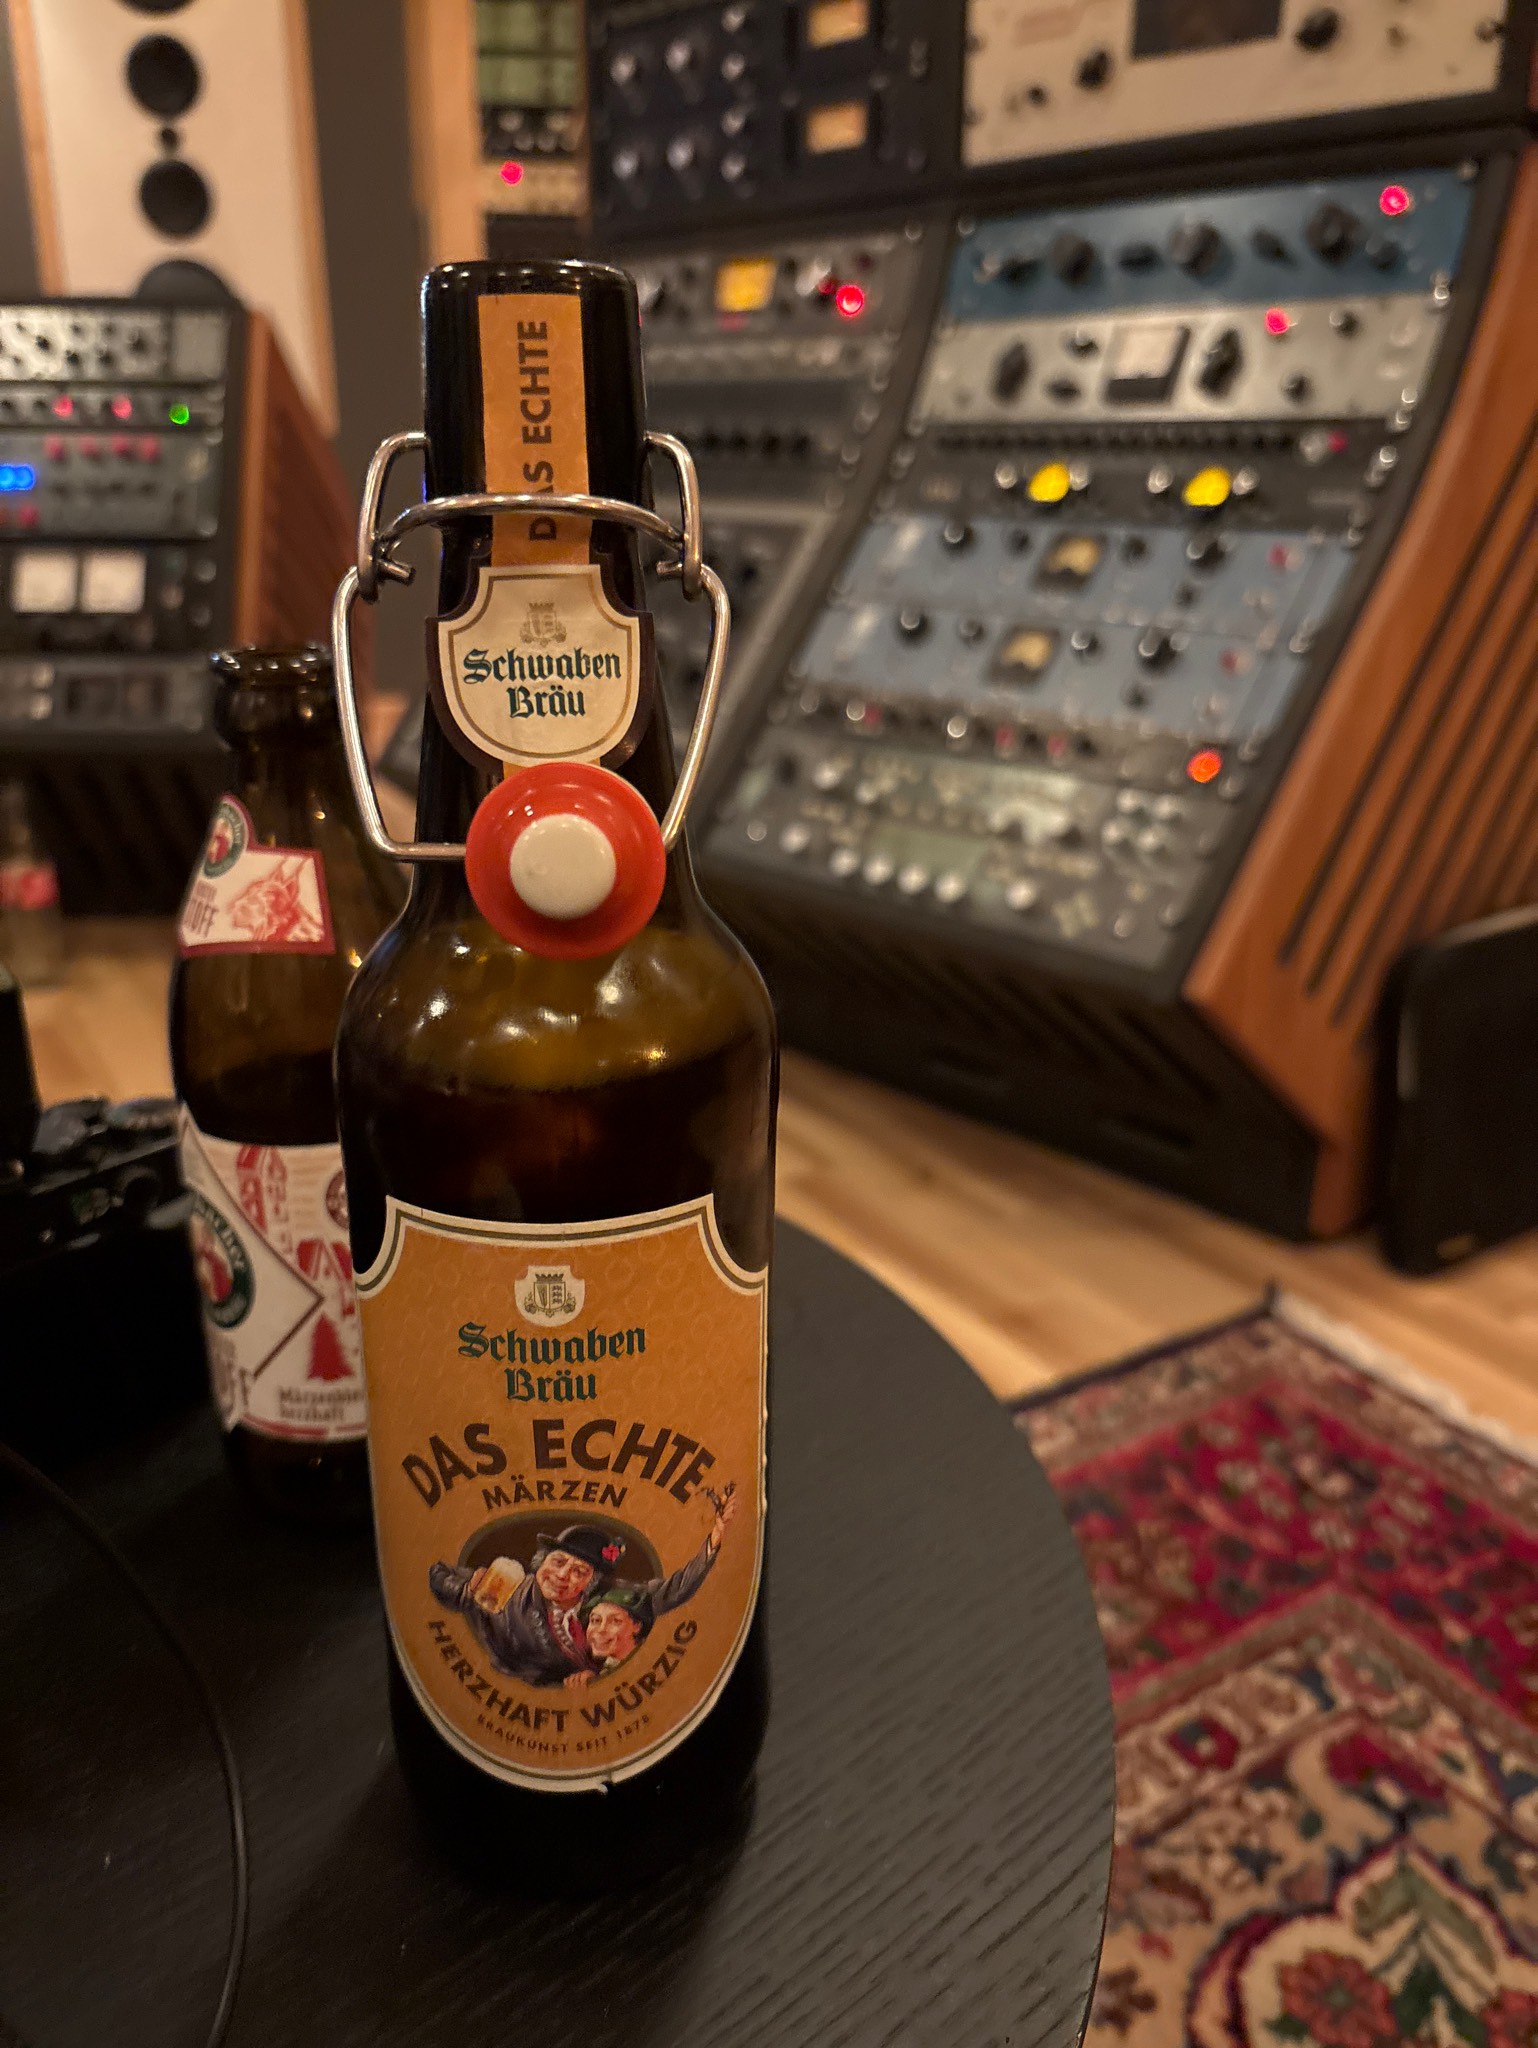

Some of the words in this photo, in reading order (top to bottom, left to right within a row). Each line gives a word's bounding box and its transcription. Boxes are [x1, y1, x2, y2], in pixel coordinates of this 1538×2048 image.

[516, 320, 552, 445] ECHTE
[463, 646, 621, 684] Schwaben
[506, 685, 586, 719] Bräu
[457, 1321, 646, 1365] Schwaben
[504, 1367, 597, 1403] Bräu
[401, 1422, 508, 1509] DAS
[532, 1418, 716, 1505] ECHTE
[480, 1474, 628, 1512] MÄRZEN
[428, 1618, 570, 1733] HERZHAFT
[580, 1618, 699, 1729] WÜRZIG
[477, 1713, 568, 1754] BRAUKUNST
[576, 1736, 608, 1752] SEIT
